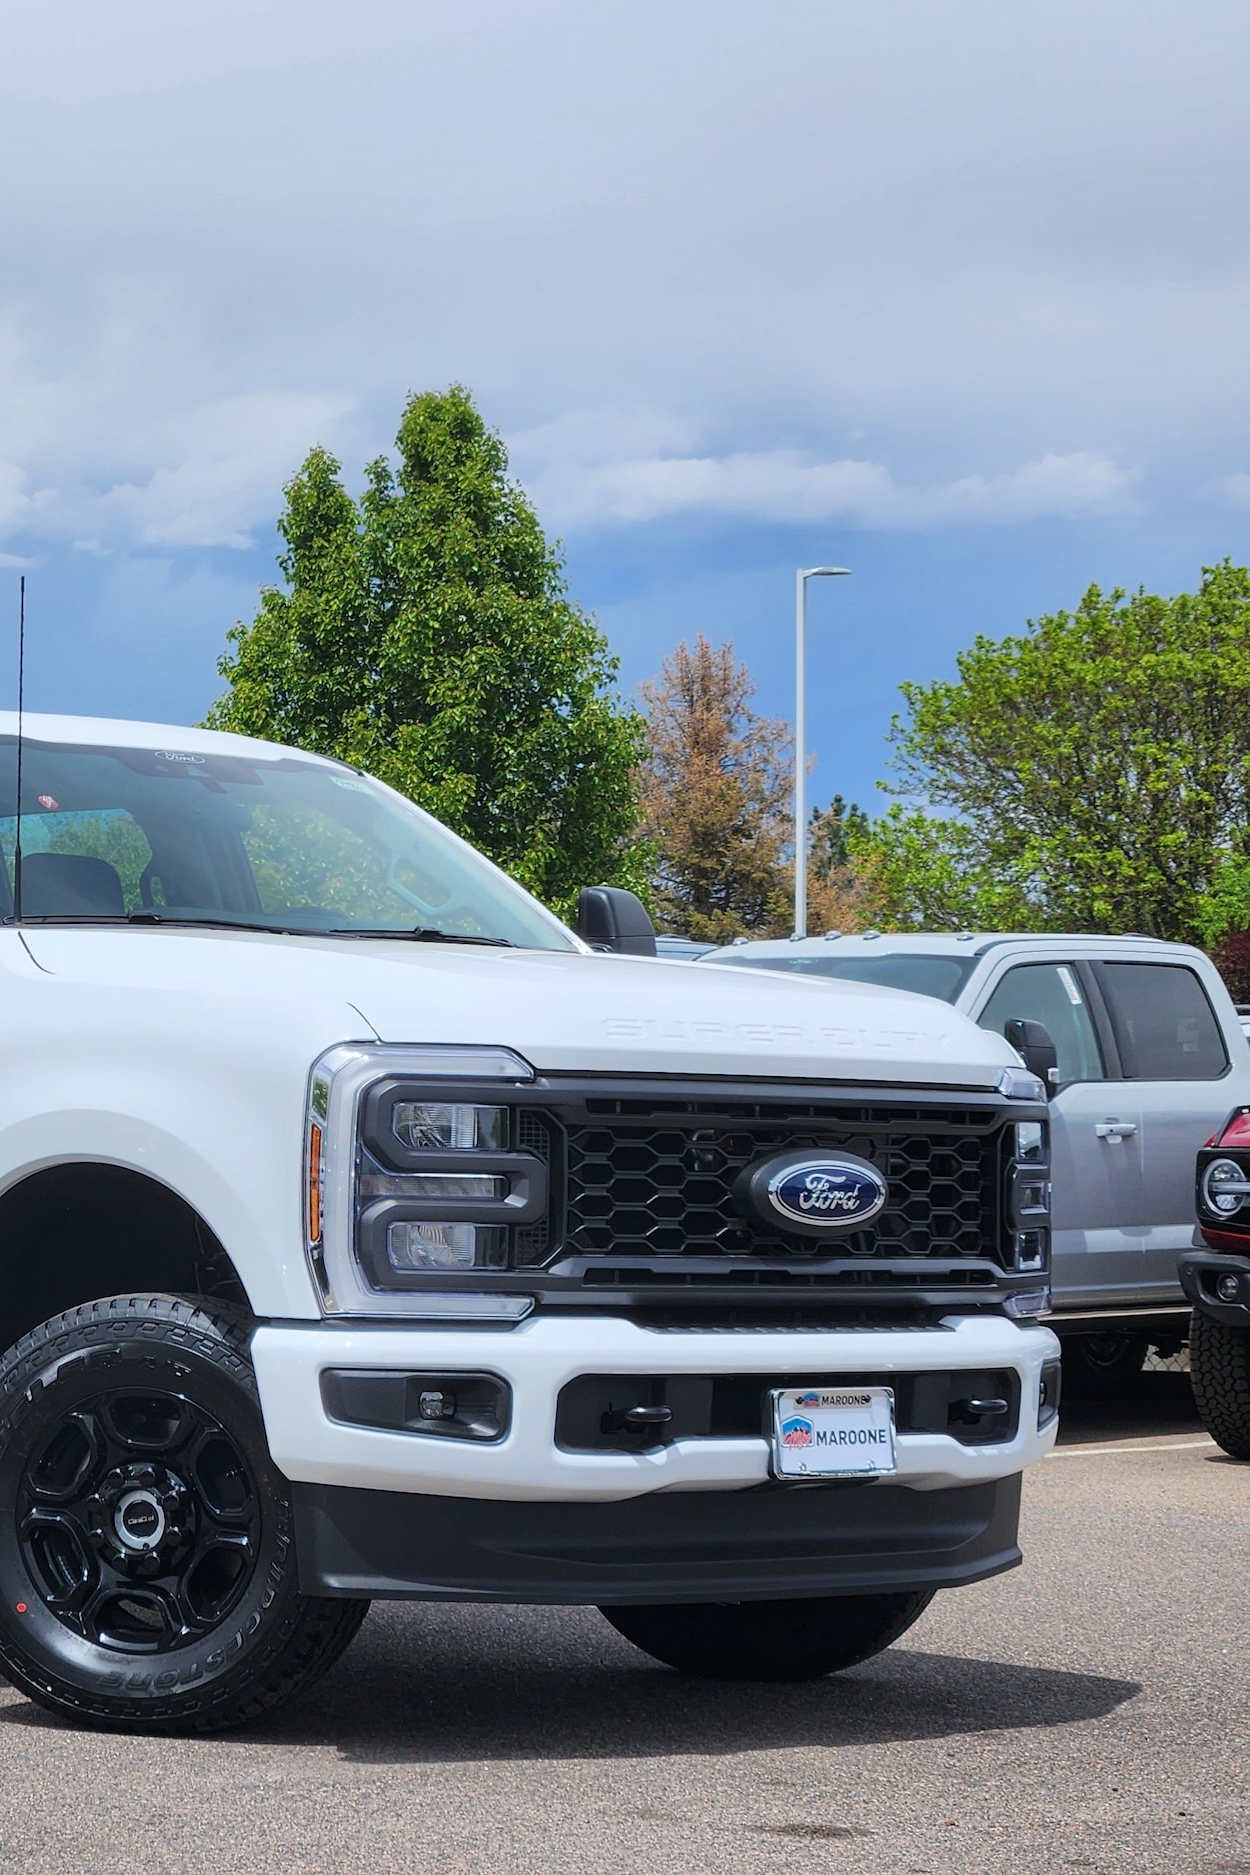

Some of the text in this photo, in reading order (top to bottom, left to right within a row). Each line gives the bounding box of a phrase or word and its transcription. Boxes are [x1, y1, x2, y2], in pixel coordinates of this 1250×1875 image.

[601, 1017, 951, 1048] SUPER DUTY
[798, 1173, 861, 1210] Ford
[821, 1395, 867, 1405] MAROONE
[816, 1429, 887, 1446] MAROONE
